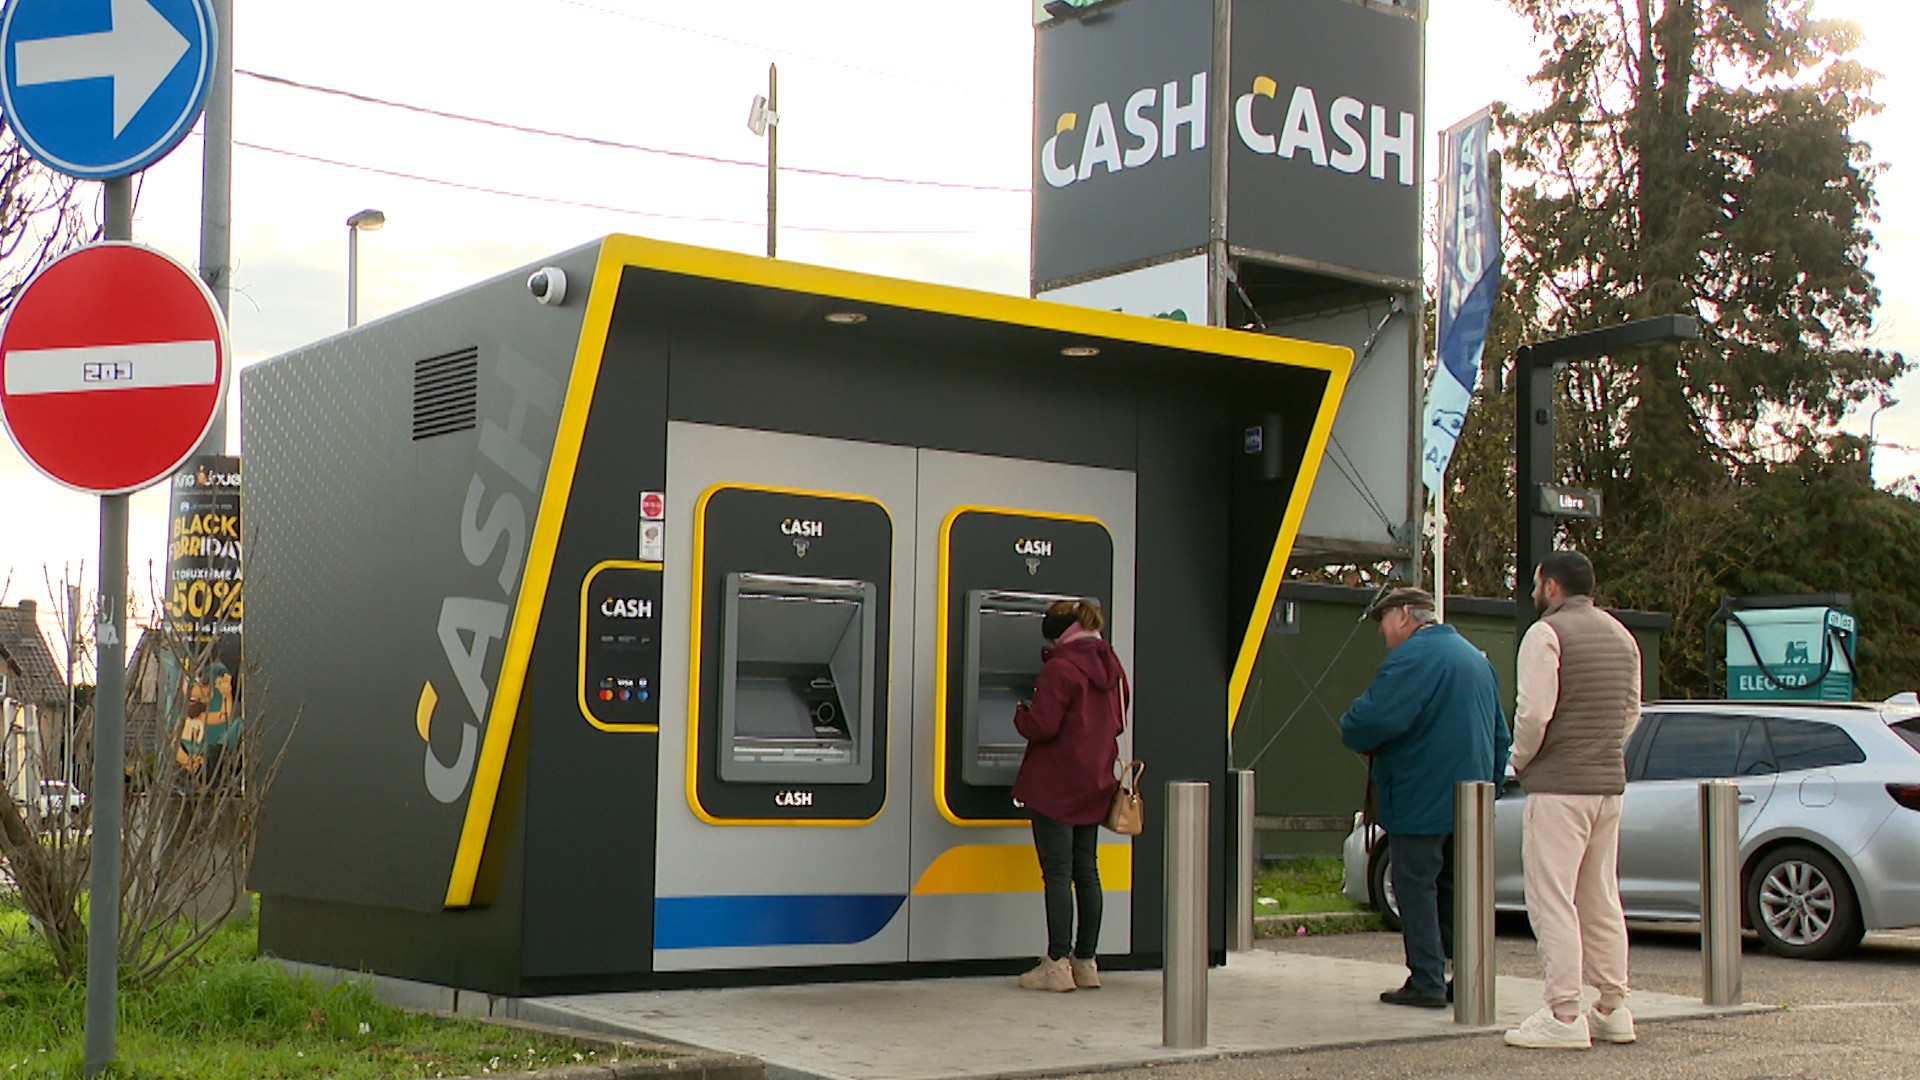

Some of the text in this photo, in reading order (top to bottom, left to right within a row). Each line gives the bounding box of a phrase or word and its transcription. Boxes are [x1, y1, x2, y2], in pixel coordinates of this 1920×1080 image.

[1041, 71, 1208, 188] CASH
[1234, 76, 1415, 186] CASH
[174, 513, 239, 538] BLACK
[780, 518, 823, 537] CASH
[1015, 538, 1052, 556] CASH
[416, 345, 561, 804] CASH
[601, 597, 653, 618] CASH
[1739, 674, 1807, 690] ELECTRA
[775, 791, 812, 806] CASH
